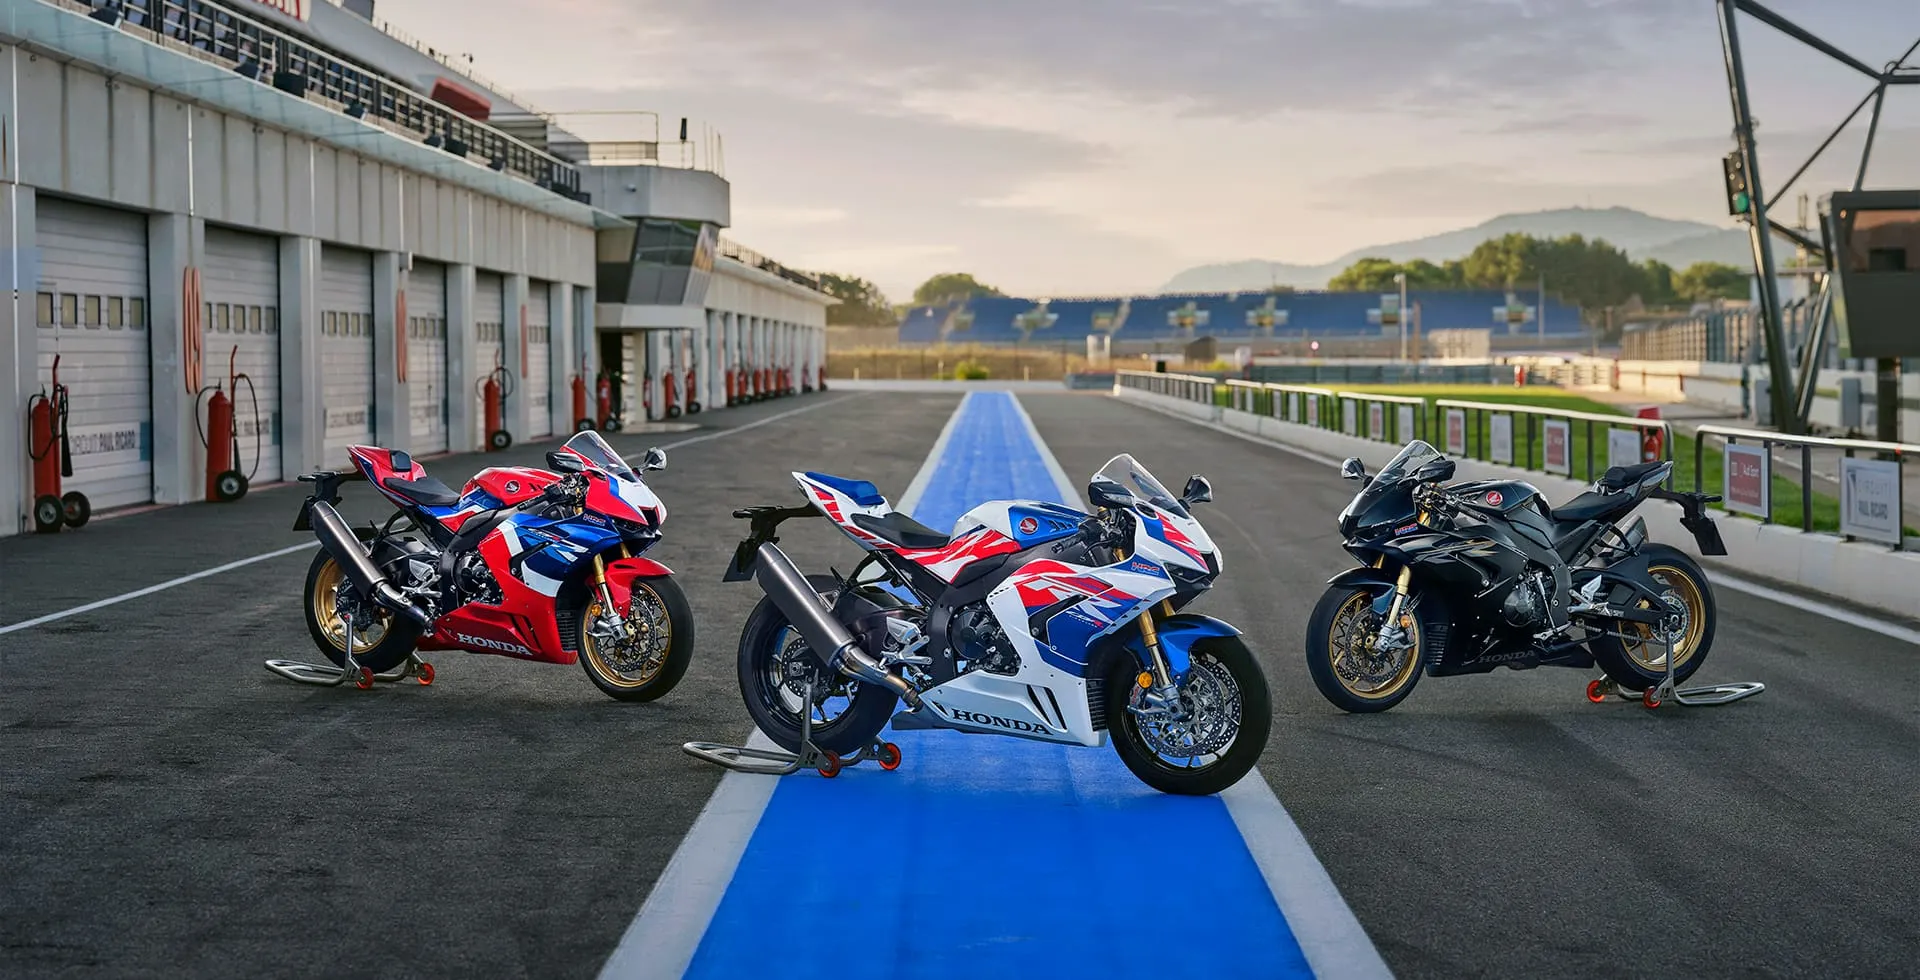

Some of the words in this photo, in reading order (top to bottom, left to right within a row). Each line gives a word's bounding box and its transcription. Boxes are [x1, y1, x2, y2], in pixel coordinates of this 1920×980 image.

[1131, 561, 1160, 576] HRC
[457, 633, 533, 655] HONDA
[1478, 650, 1536, 664] HONDA
[952, 709, 1054, 735] HONDA
